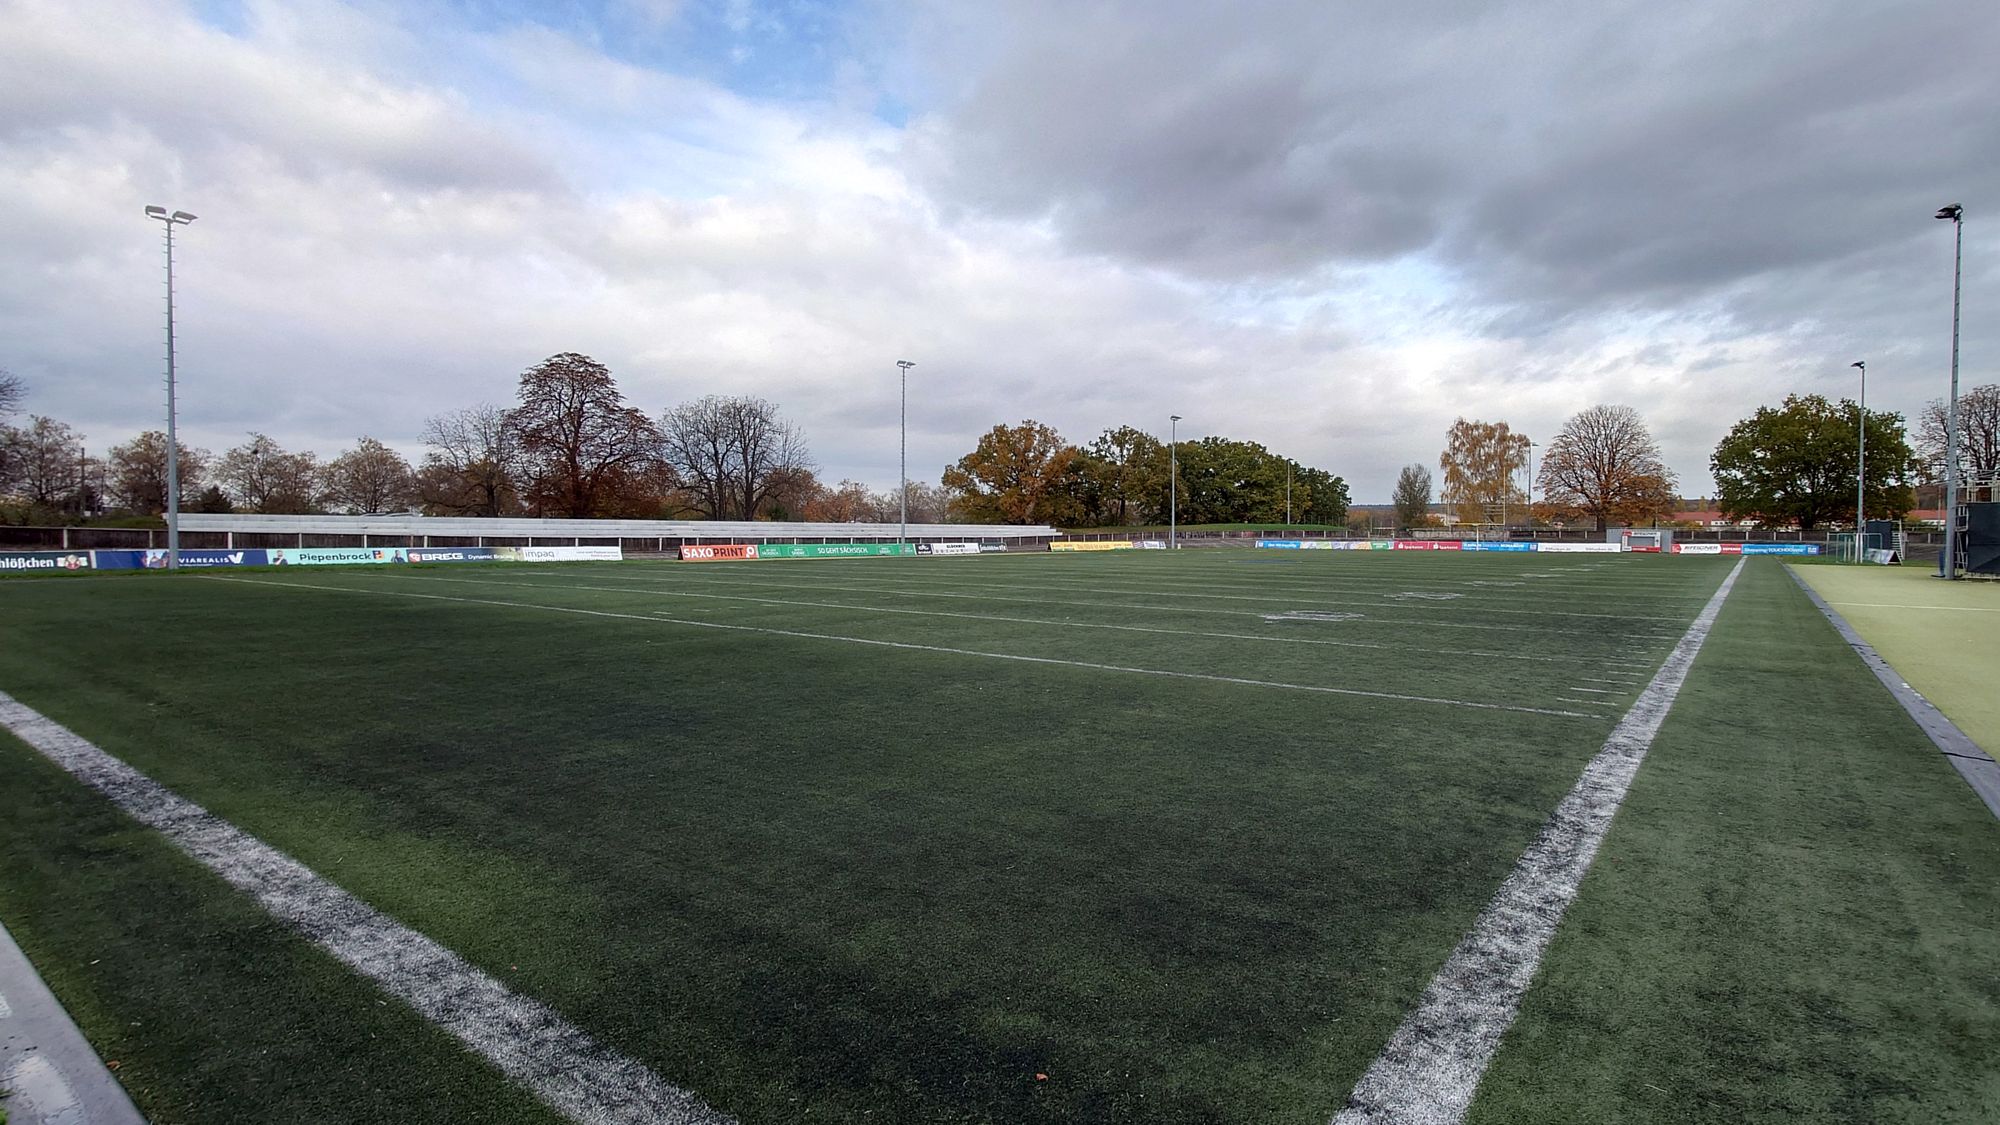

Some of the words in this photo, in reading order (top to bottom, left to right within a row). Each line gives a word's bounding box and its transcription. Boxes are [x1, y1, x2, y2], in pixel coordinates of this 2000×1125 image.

[421, 553, 464, 561] BREG
[684, 547, 744, 558] SAXOPRINT
[299, 553, 371, 562] Piepenbrock
